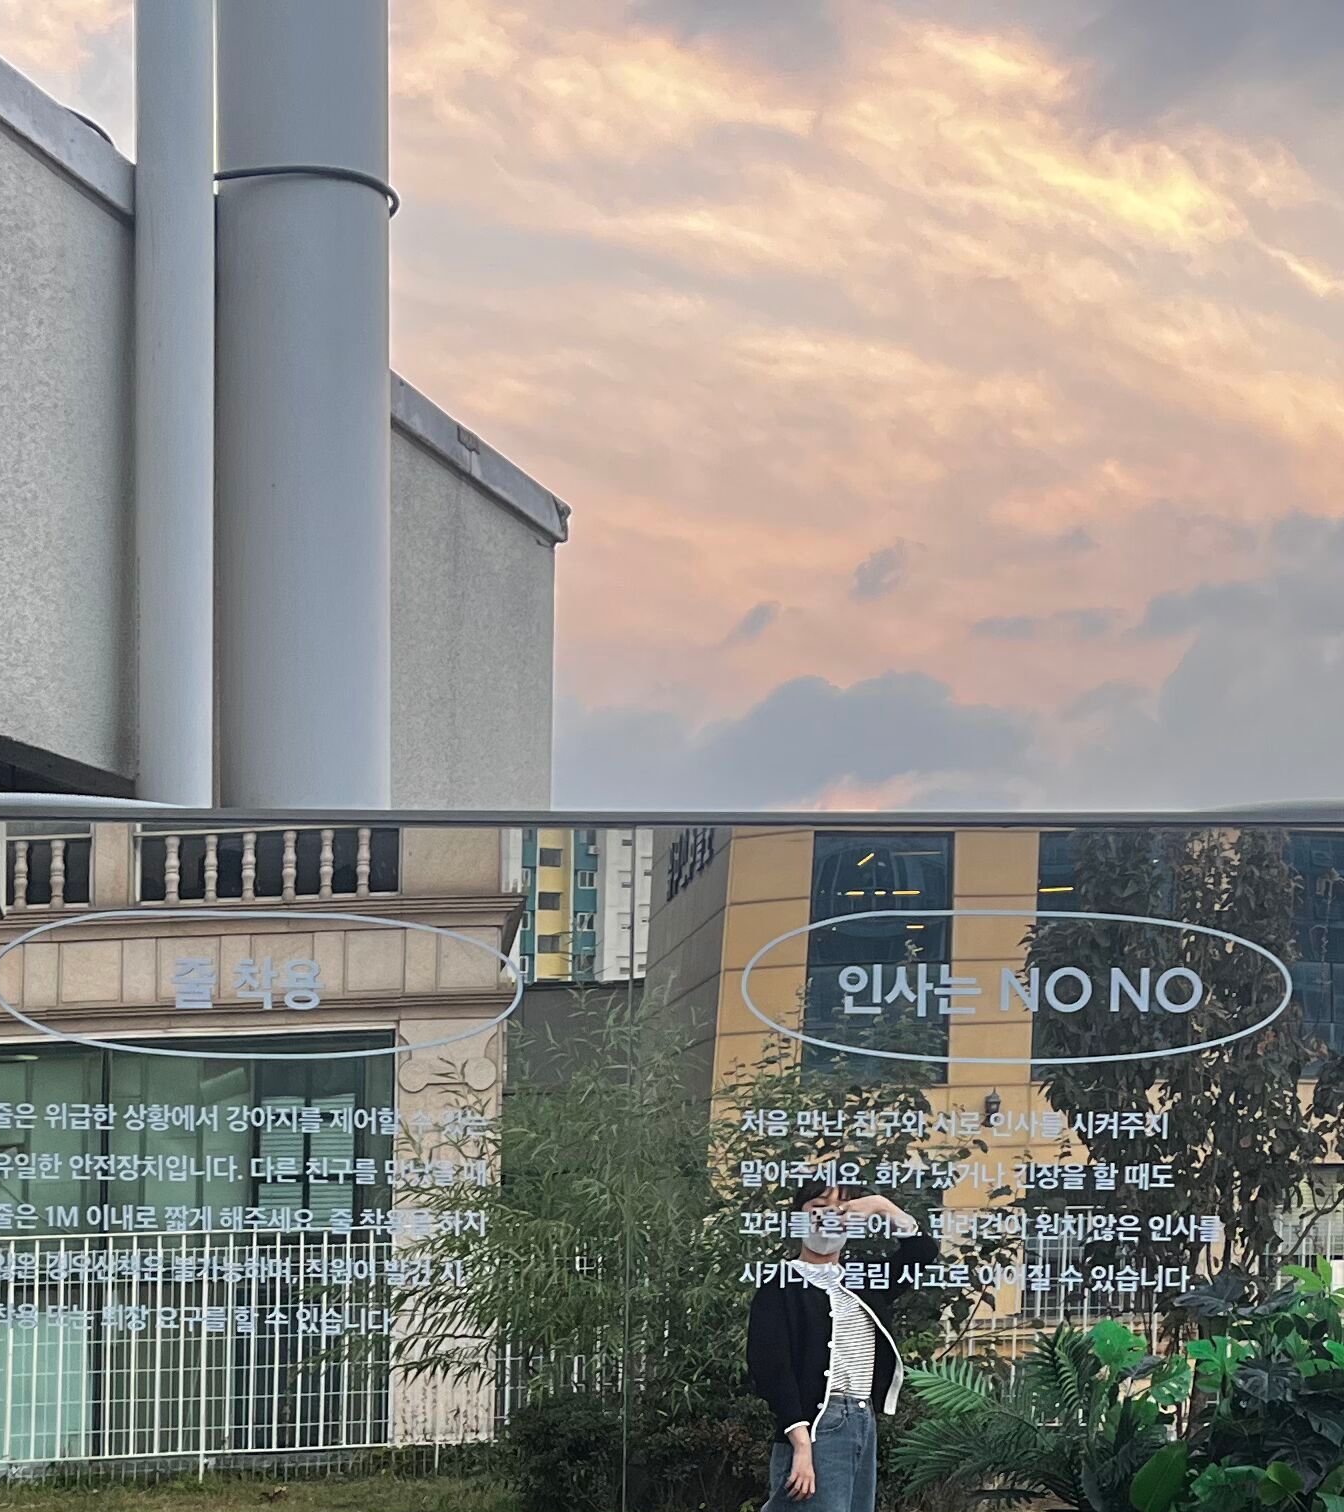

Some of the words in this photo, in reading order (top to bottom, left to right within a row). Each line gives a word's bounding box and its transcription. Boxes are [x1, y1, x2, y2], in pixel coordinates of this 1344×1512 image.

[171, 956, 217, 1009] 줄
[233, 956, 326, 1010] 착용
[838, 963, 981, 1017] 인사는
[1000, 967, 1092, 1012] NO
[1110, 967, 1203, 1013] NO
[44, 1103, 116, 1130] 위급한
[123, 1104, 218, 1132] 상황에서
[226, 1106, 323, 1133] 강아지를
[330, 1107, 401, 1135] 제어할
[410, 1109, 433, 1133] 수
[741, 1109, 790, 1137] 처음
[797, 1110, 846, 1137] 만난
[853, 1110, 925, 1137] 친구와
[933, 1111, 981, 1137] 서로
[990, 1111, 1063, 1137] 인사를
[1073, 1111, 1169, 1139] 시켜주지
[69, 1154, 243, 1182] 안전장치입니다.
[250, 1156, 298, 1183] 다른
[306, 1157, 377, 1184] 친구를
[463, 1160, 487, 1187] 때
[741, 1159, 867, 1188] 말아주세요.
[875, 1160, 926, 1188] 화가
[932, 1161, 1005, 1189] 났거나
[1015, 1163, 1086, 1190] 긴장을
[1093, 1163, 1118, 1190] 할
[1125, 1164, 1175, 1191] 때도
[45, 1206, 78, 1227] 1M
[87, 1205, 158, 1231] 이내로
[164, 1205, 212, 1232] 짧게
[329, 1208, 353, 1235] 줄
[360, 1208, 434, 1236] 착용을
[439, 1210, 488, 1237] 하지
[739, 1211, 810, 1239] 꼬리를
[819, 1212, 922, 1239] 흔들어요.
[929, 1212, 1027, 1240] 반려견이
[1035, 1213, 1084, 1241] 원치
[1091, 1214, 1141, 1241] 않은
[1149, 1215, 1223, 1242] 인사를
[306, 1257, 375, 1285] 직원이
[385, 1259, 431, 1286] 발견
[439, 1260, 464, 1286] 시
[844, 1262, 890, 1289] 물림
[897, 1263, 970, 1290] 사고로
[978, 1265, 1050, 1292] 이어질
[1059, 1265, 1083, 1292] 수
[1091, 1265, 1195, 1293] 있습니다.
[156, 1307, 226, 1332] 요구를
[234, 1307, 256, 1332] 할
[264, 1308, 288, 1333] 수
